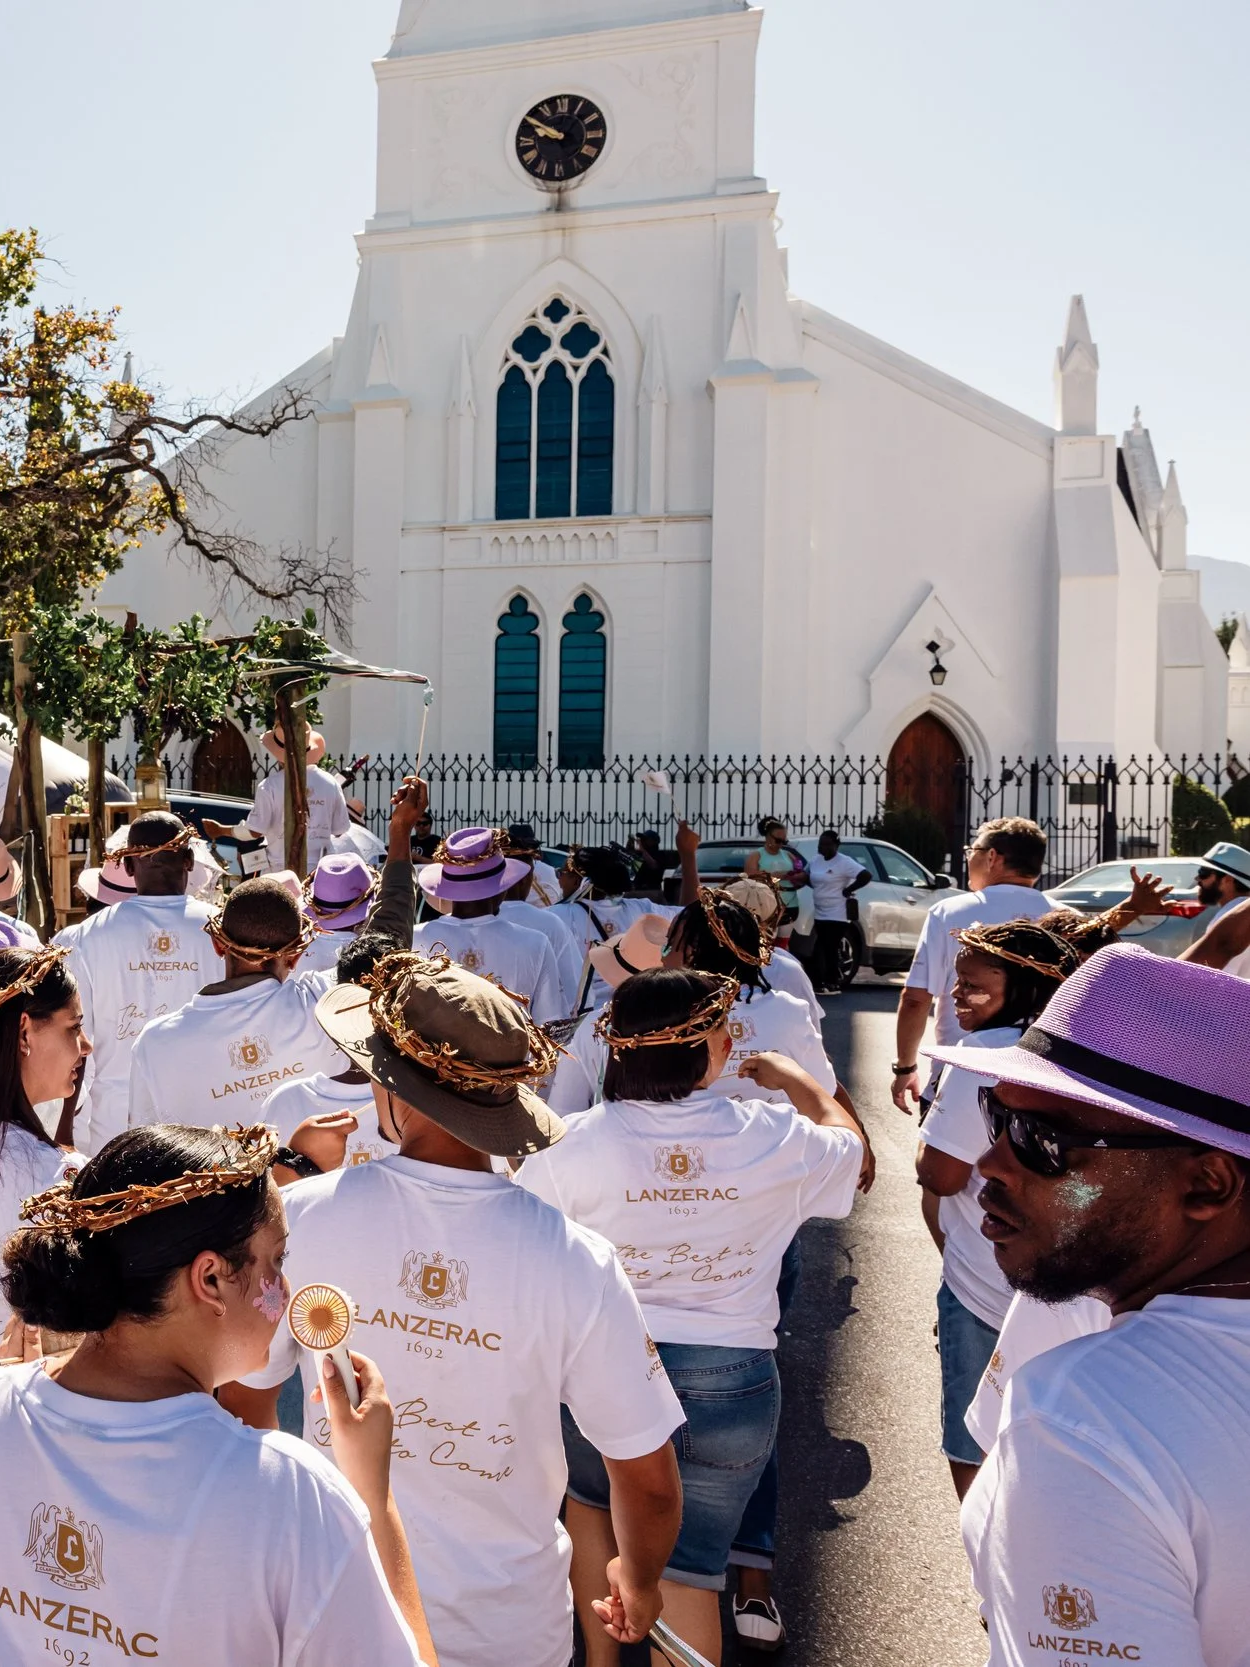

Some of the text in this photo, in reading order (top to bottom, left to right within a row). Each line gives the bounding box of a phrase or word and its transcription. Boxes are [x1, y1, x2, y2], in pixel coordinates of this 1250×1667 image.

[129, 961, 198, 971] LANZERAC
[120, 1003, 147, 1022] The
[211, 1062, 305, 1099] LANZERAC
[626, 1188, 739, 1202] LANZERAC
[669, 1207, 698, 1217] 1692
[663, 1243, 731, 1265] Best
[736, 1242, 757, 1256] is
[354, 1305, 502, 1351] LANZERAC
[406, 1341, 444, 1359] 1692
[393, 1398, 517, 1445] Best is
[44, 1637, 91, 1667] 1692
[1028, 1632, 1141, 1660] LANZERAC
